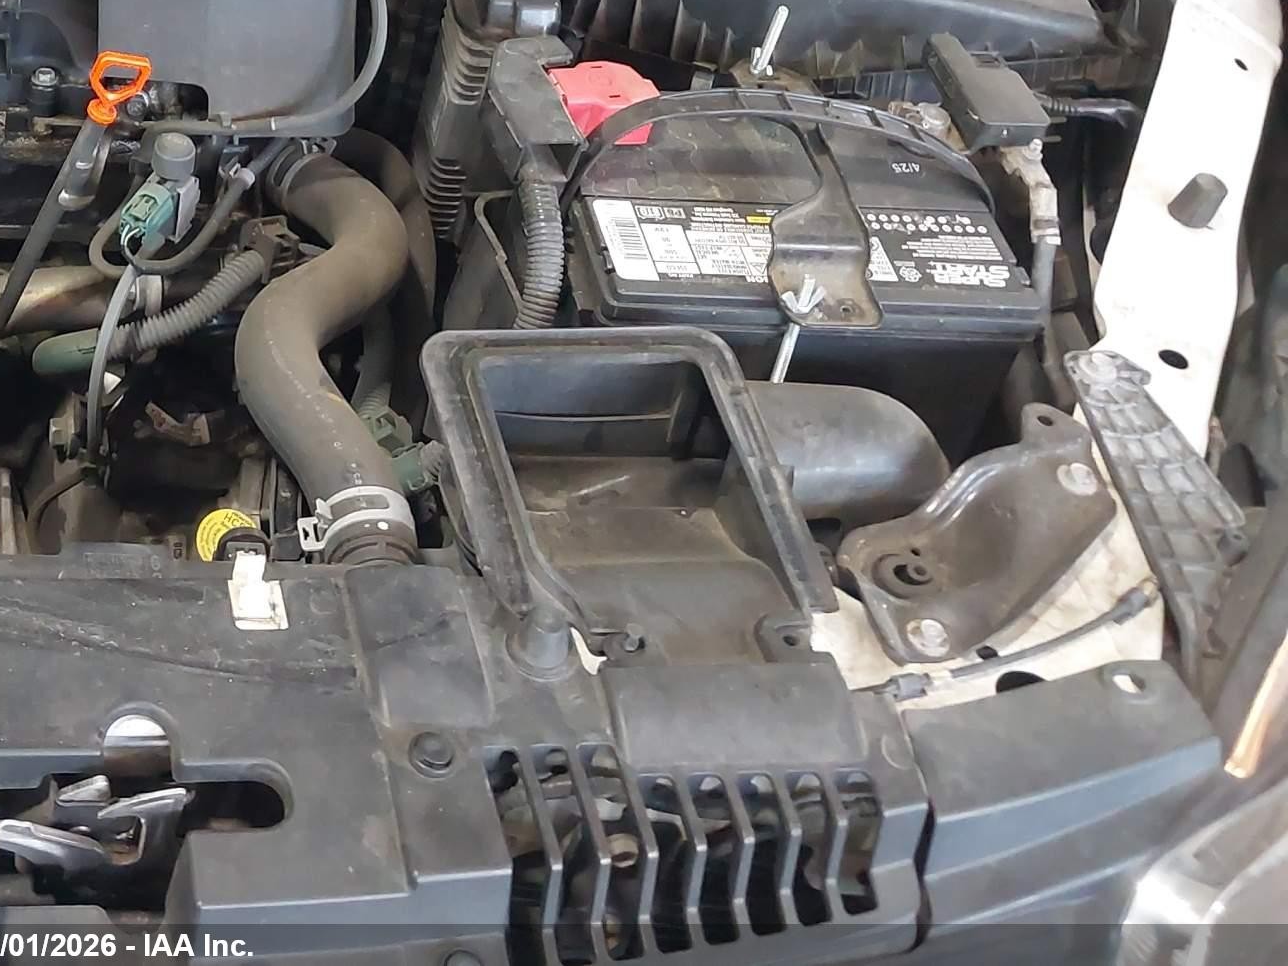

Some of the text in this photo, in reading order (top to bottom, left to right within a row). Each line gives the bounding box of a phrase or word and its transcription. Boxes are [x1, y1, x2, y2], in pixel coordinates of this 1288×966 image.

[891, 161, 921, 174] 4/25
[930, 264, 1010, 280] START
[934, 272, 1008, 288] SUPER
